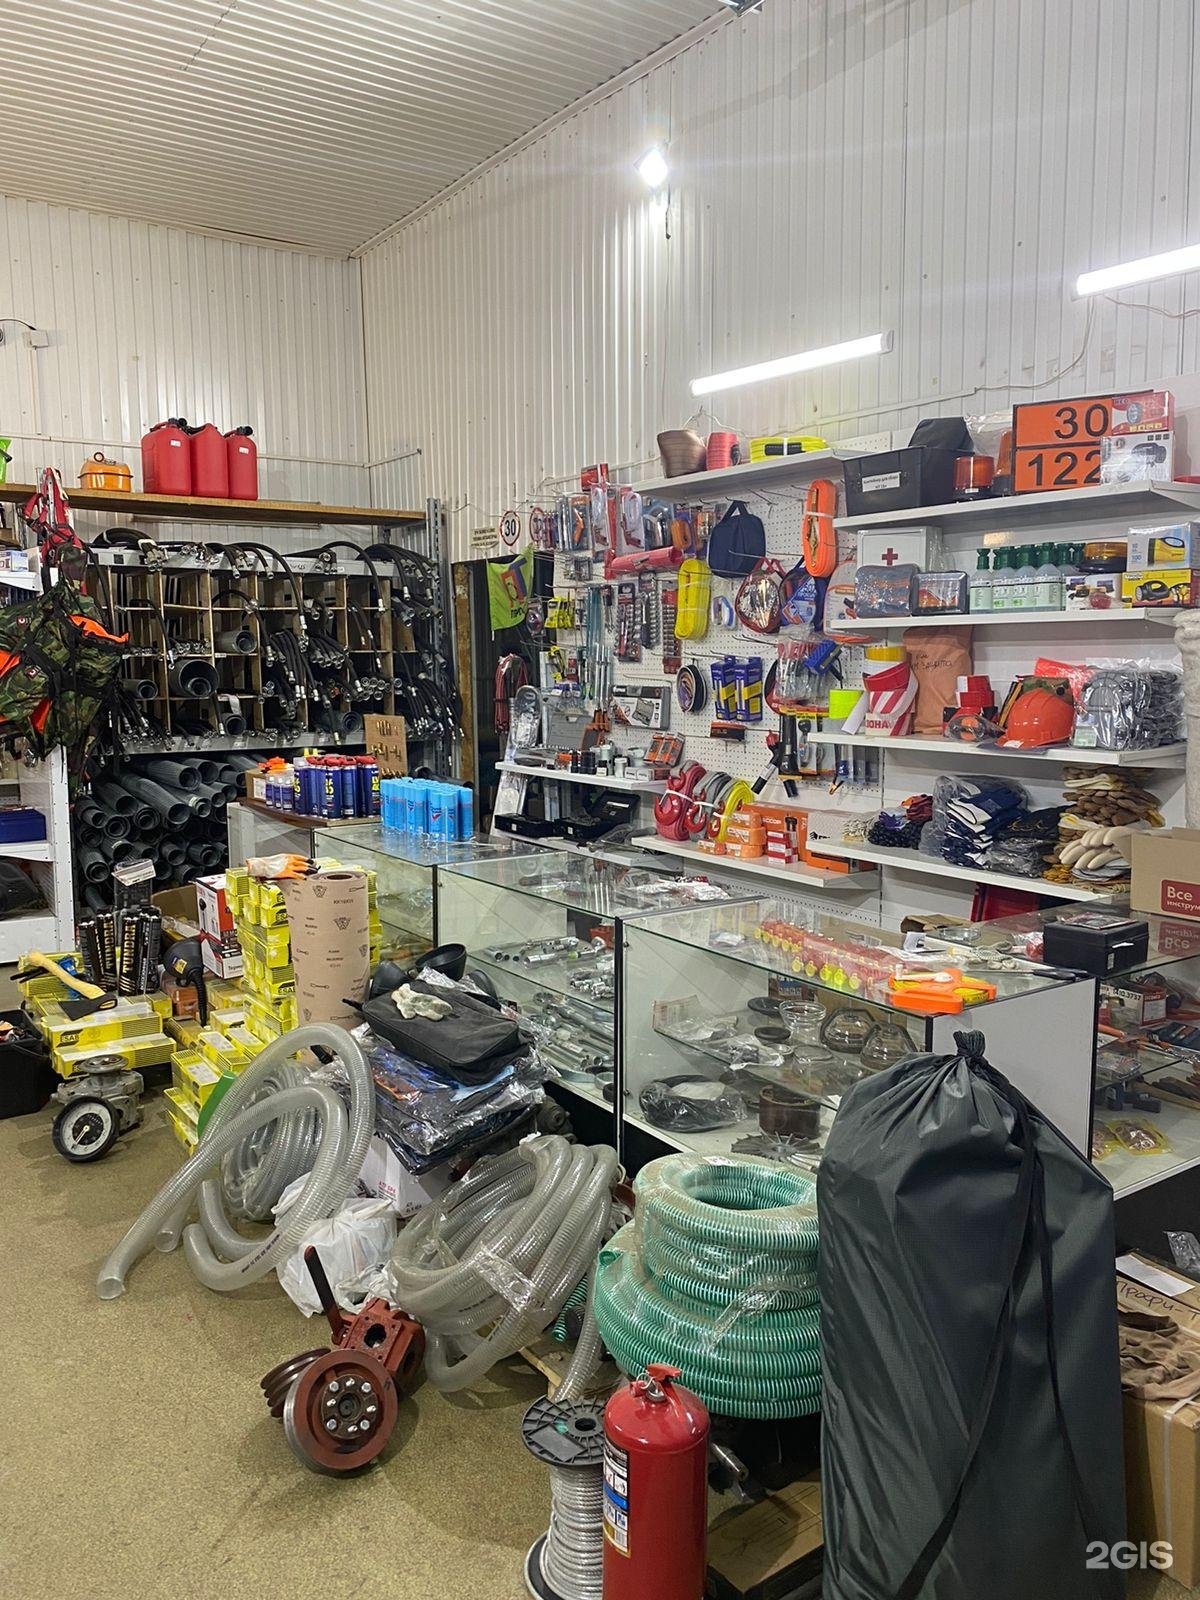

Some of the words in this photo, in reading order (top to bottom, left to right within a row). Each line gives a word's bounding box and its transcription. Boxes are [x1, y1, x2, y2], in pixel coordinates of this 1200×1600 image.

[1054, 403, 1109, 439] 30
[504, 519, 516, 537] 30
[1167, 886, 1193, 901] Все
[103, 921, 114, 970] TUNDRA
[122, 924, 136, 974] TUNDRA
